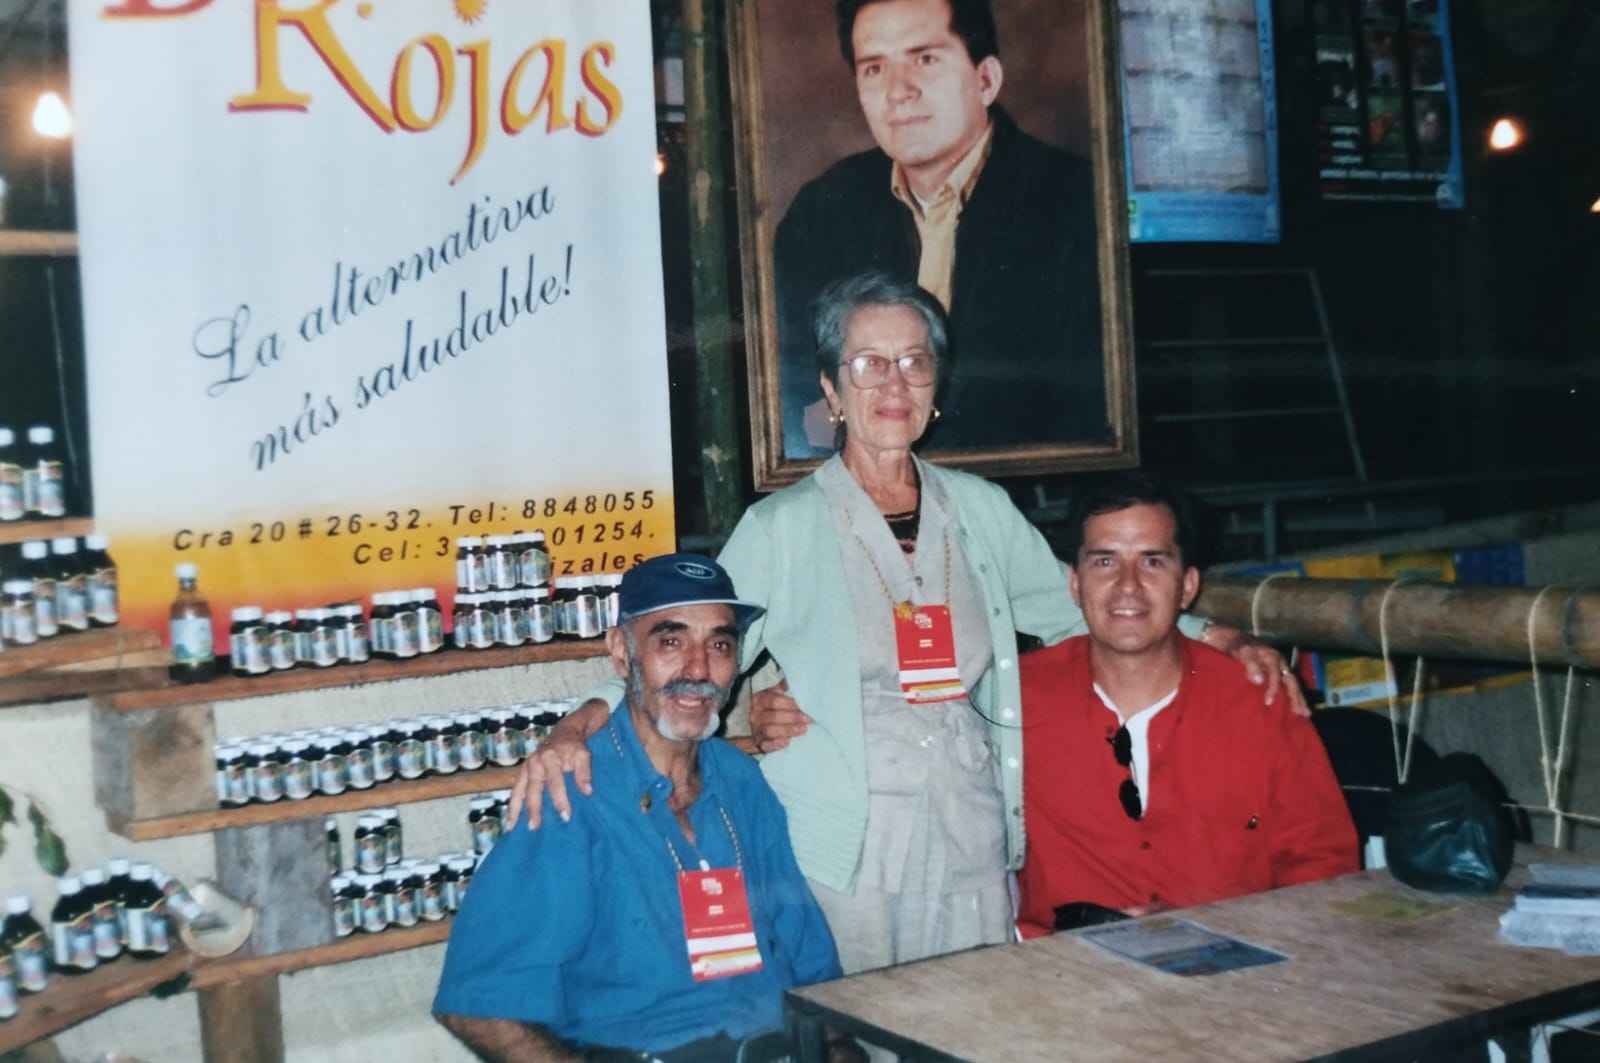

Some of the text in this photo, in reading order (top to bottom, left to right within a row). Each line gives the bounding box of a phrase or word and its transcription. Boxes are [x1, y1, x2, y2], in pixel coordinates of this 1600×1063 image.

[228, 0, 622, 186] Rojas
[192, 185, 556, 398] La alternativa
[250, 244, 576, 471] más saludable!
[173, 529, 234, 551] Cra
[250, 522, 286, 544] 20
[326, 509, 432, 537] 26-32.
[449, 502, 508, 526] Tel:
[522, 489, 654, 520] 8848055
[353, 540, 422, 565] Cel:
